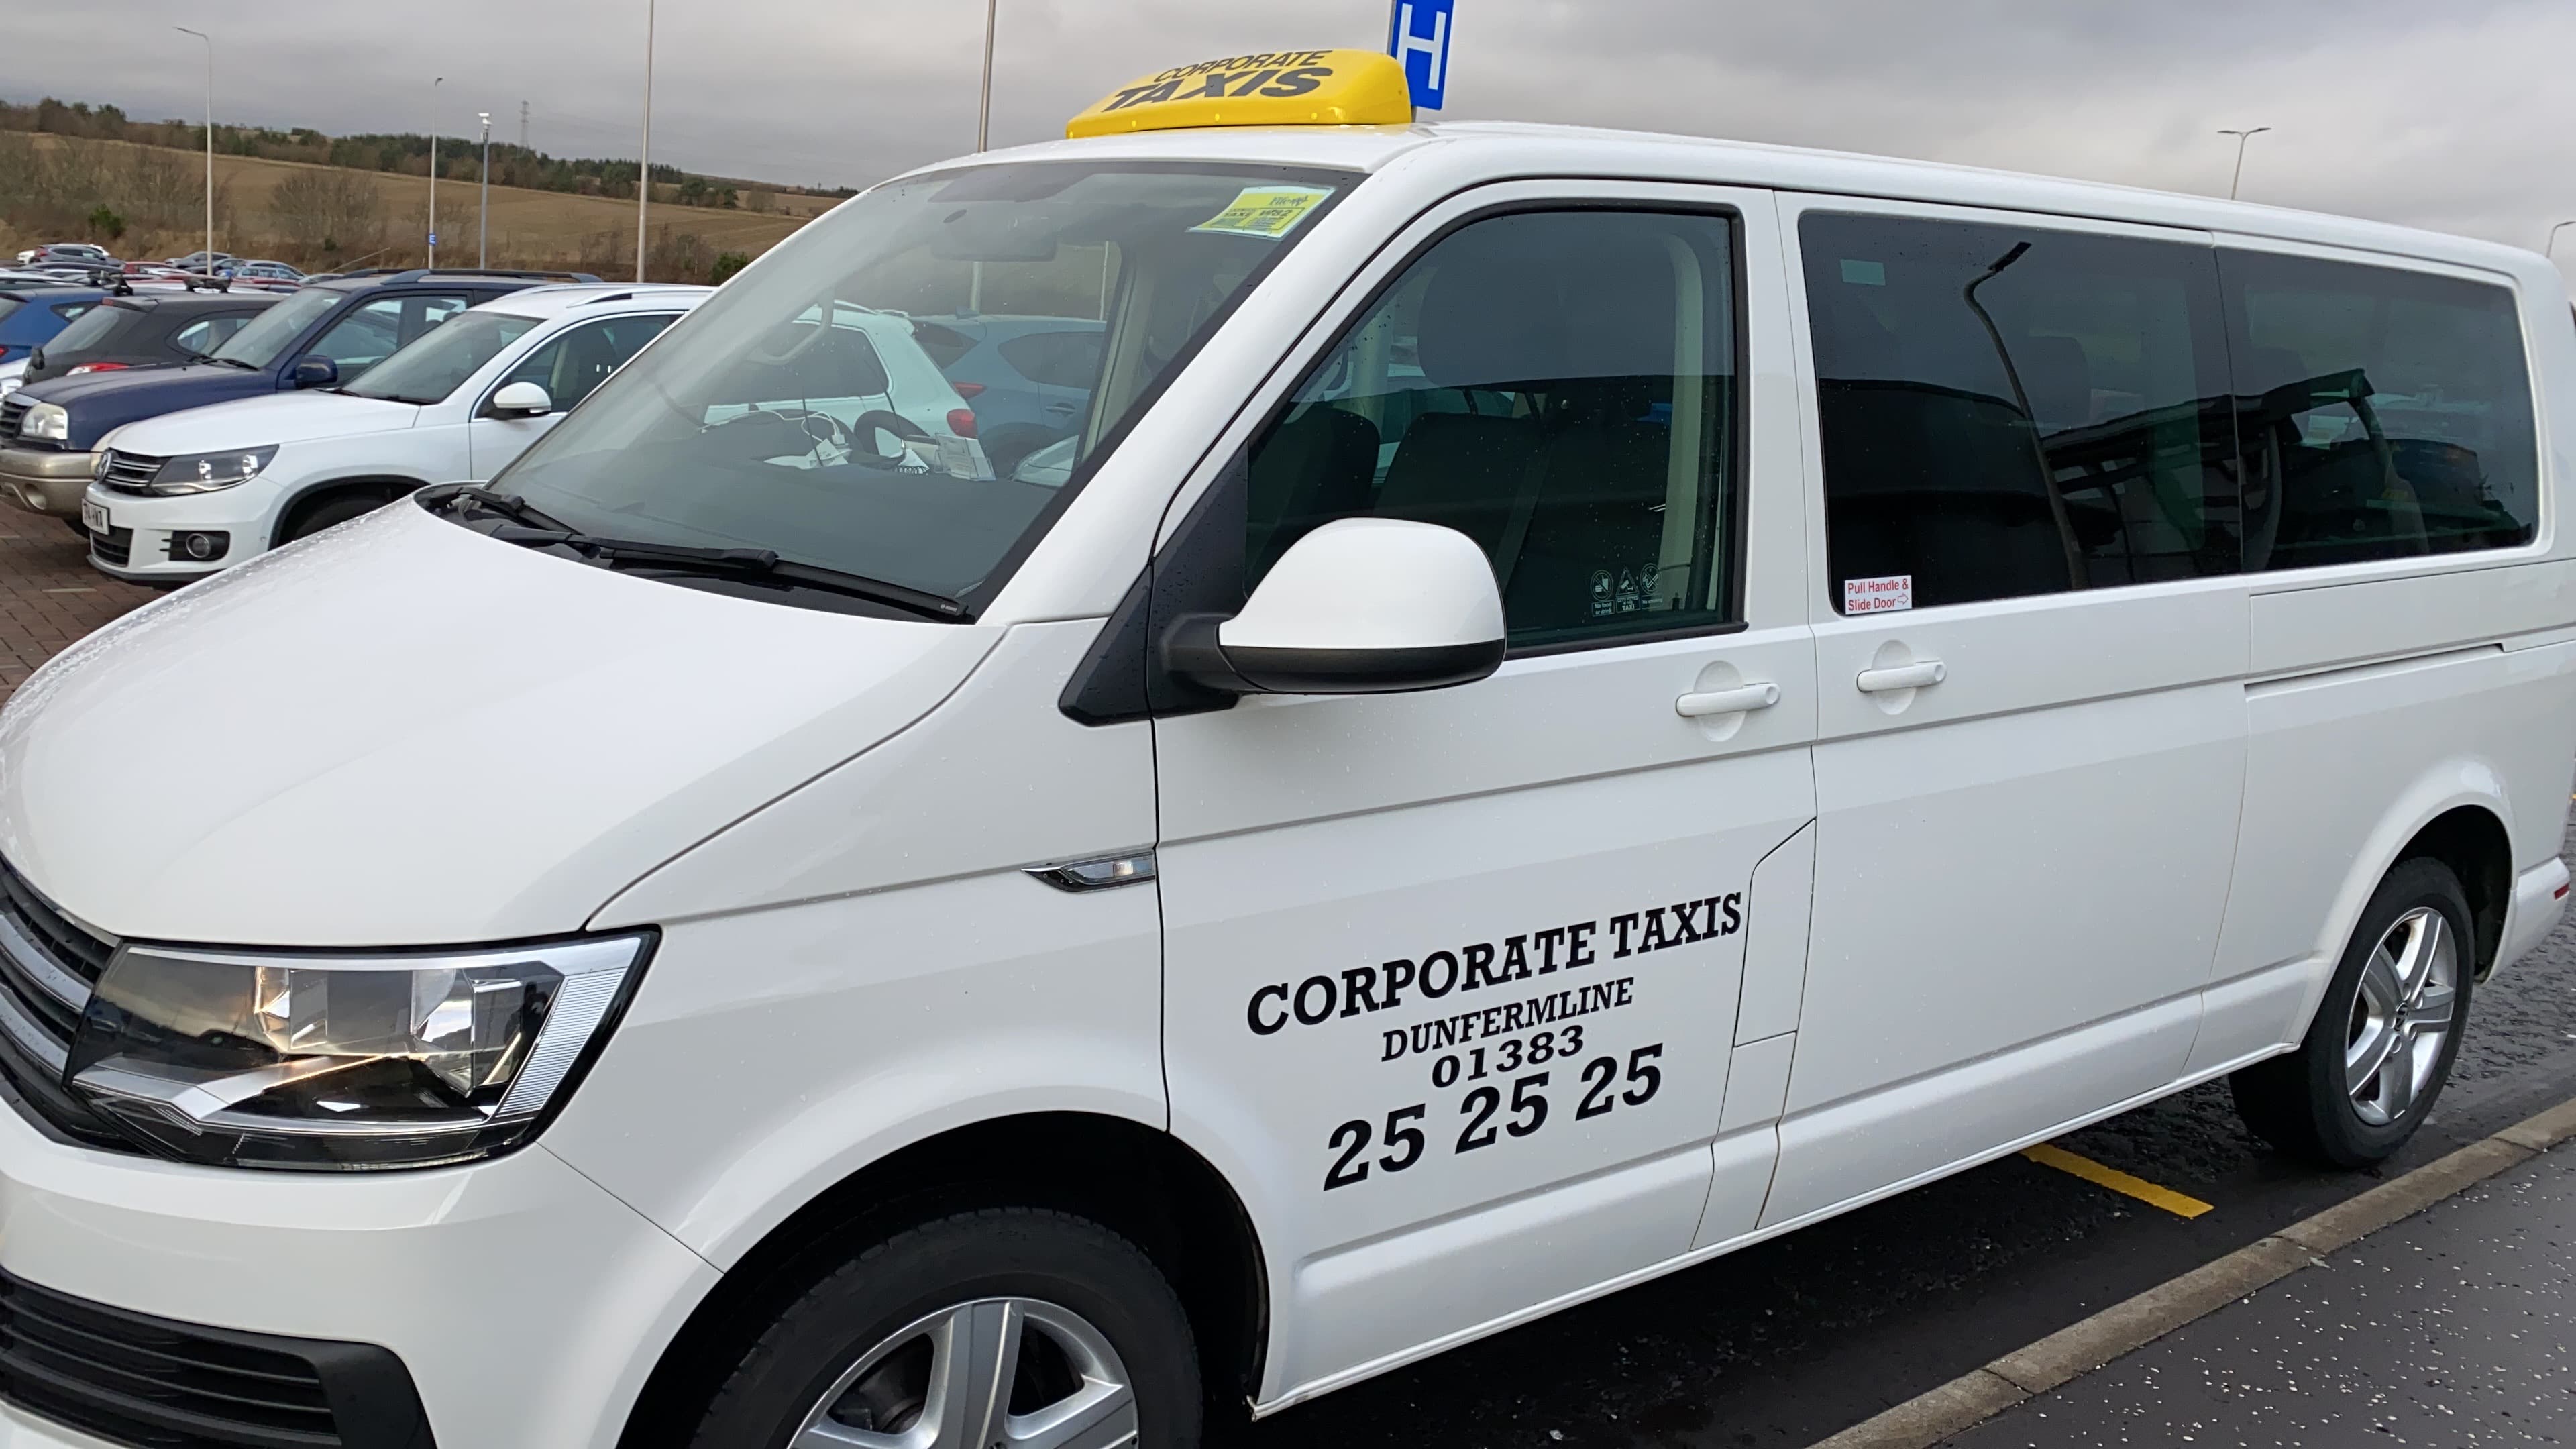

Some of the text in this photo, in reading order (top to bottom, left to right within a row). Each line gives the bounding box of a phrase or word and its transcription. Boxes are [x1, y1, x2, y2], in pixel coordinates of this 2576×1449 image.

[1153, 50, 1334, 83] CORPORATE
[1397, 3, 1447, 91] H
[1101, 67, 1334, 113] TAXIS
[1848, 578, 1909, 594] Pull Handle &
[1848, 598, 1896, 611] Slide Door
[1247, 892, 1741, 1036] CORPORATE TAXIS
[1381, 977, 1634, 1062] DUNFERMLINE
[1432, 1024, 1583, 1088] 01383
[1323, 1042, 1663, 1192] 25 25 25
